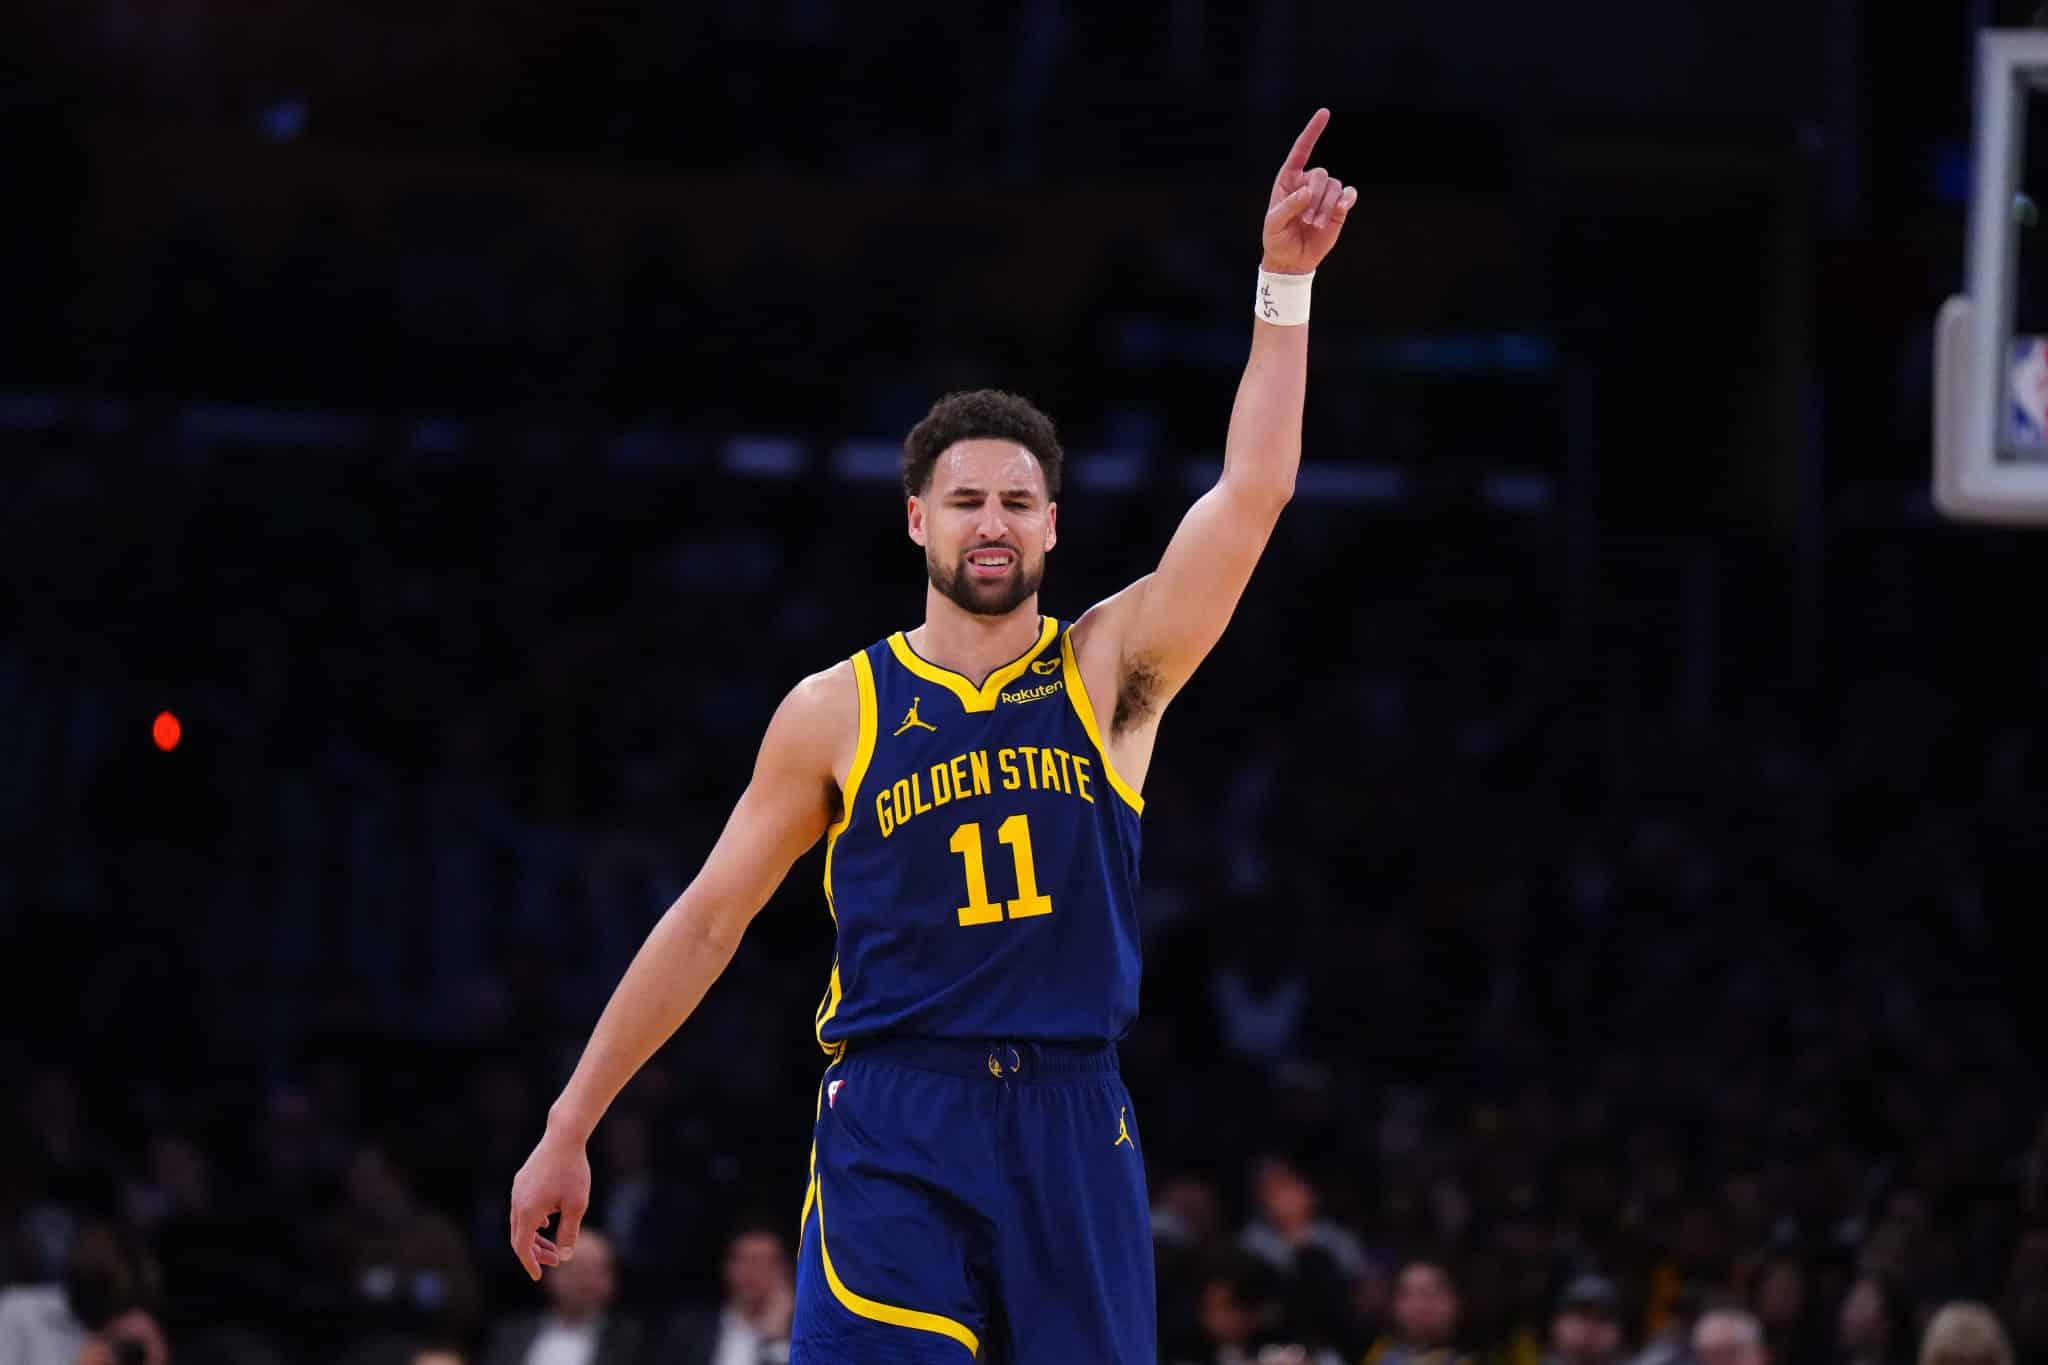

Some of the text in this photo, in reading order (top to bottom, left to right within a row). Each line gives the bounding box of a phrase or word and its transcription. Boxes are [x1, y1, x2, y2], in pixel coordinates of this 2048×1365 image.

[1001, 680, 1063, 704] Rakuten
[876, 747, 1095, 838] GOLDEN STATE
[950, 814, 1053, 927] 11
